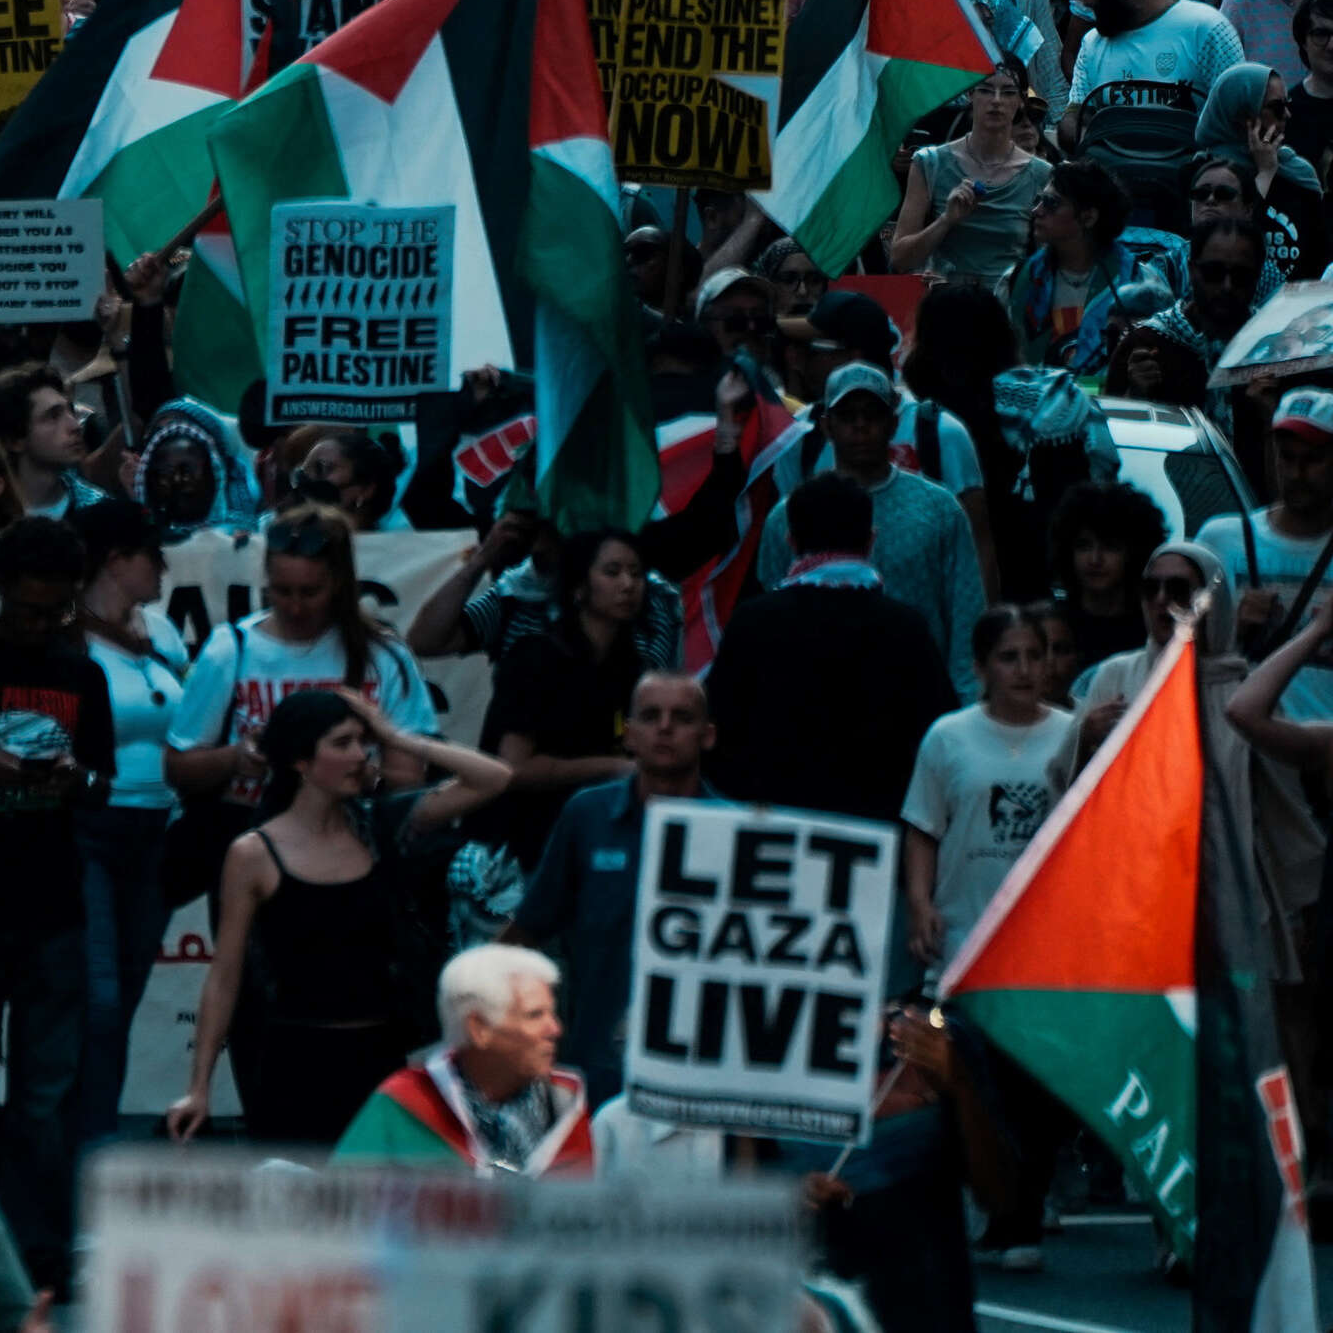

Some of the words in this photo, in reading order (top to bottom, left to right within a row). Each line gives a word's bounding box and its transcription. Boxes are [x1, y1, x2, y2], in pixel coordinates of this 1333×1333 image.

[623, 25, 702, 70] END
[711, 26, 780, 71] THE
[615, 103, 762, 179] NOW!
[24, 227, 51, 237] YOU
[285, 217, 361, 246] STOP
[367, 216, 438, 245] THE
[285, 244, 438, 278] GENOCIDE
[45, 281, 79, 291] STOP
[285, 316, 437, 352] FREE
[283, 352, 437, 387] PALESTINE
[655, 819, 878, 912] LET
[650, 906, 870, 976] GAZA
[642, 976, 862, 1078] LIVE
